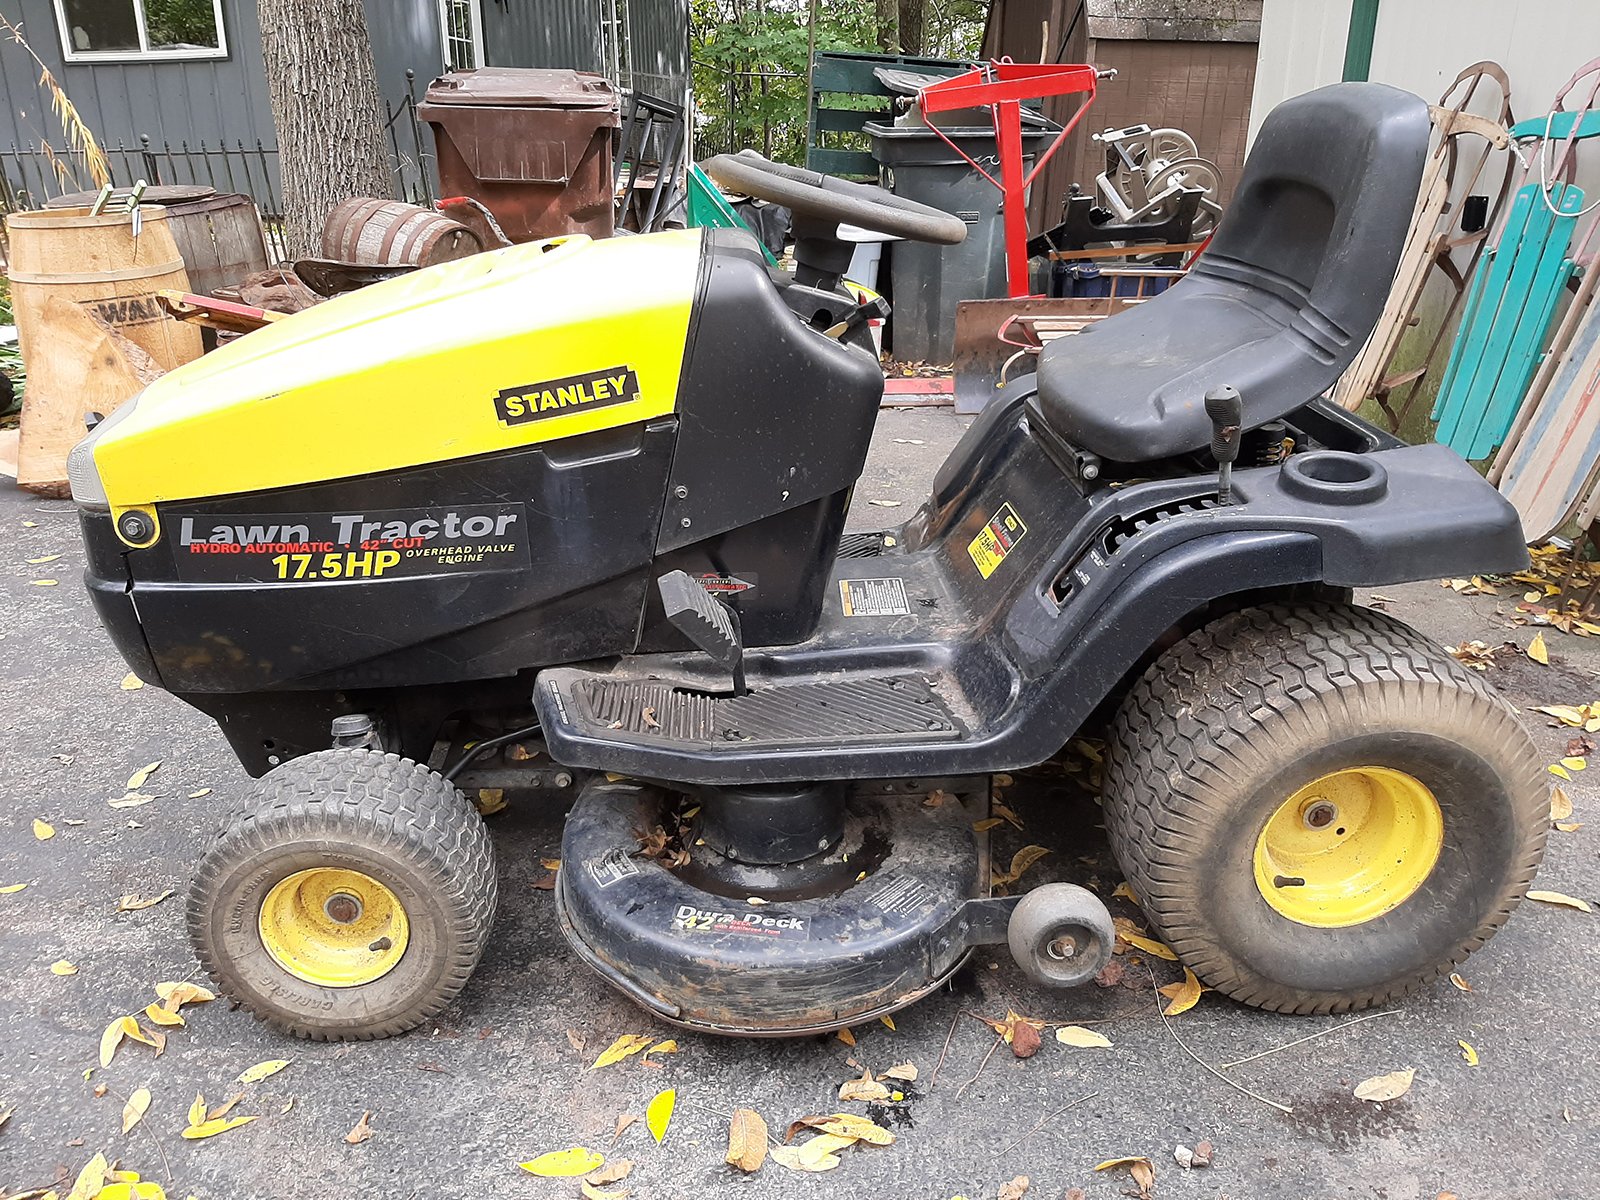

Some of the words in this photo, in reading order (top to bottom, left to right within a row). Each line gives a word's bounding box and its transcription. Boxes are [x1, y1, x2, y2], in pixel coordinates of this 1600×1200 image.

[505, 374, 627, 417] STANLEY
[180, 517, 310, 546] Lawn
[331, 512, 517, 545] Tractor
[190, 542, 242, 554] HYDRO
[244, 541, 334, 554] AUTOMATIC
[360, 539, 389, 551] 42"
[392, 536, 425, 549] CUT
[405, 546, 472, 558] OVERHEAD
[477, 543, 515, 553] VALVE
[271, 550, 401, 579] 17.5HP
[437, 553, 484, 565] ENGINE
[676, 905, 735, 923] Dura
[742, 913, 805, 931] Deck
